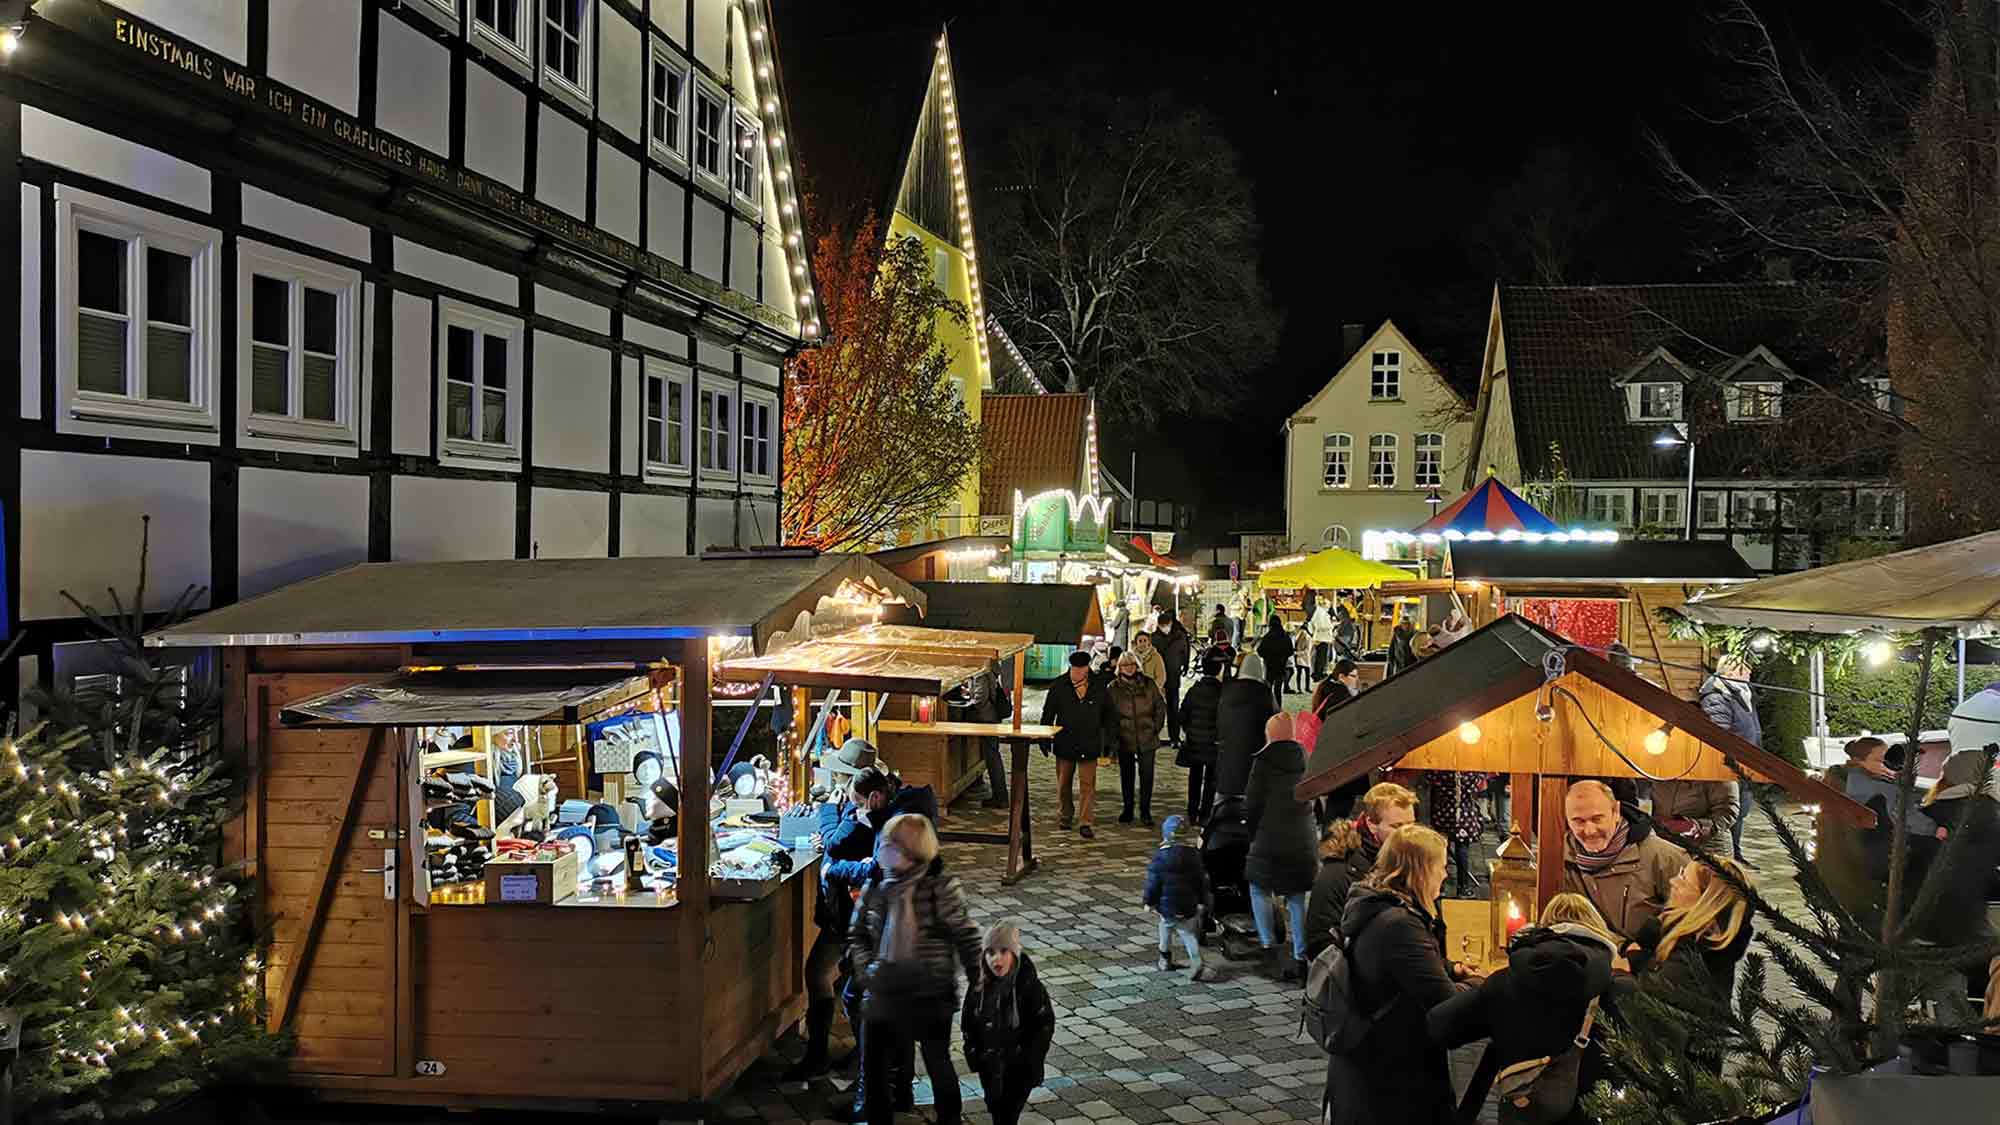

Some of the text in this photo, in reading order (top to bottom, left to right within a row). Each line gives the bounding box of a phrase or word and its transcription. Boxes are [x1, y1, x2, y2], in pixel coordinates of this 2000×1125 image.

[115, 18, 213, 81] EINSTMALS
[223, 67, 256, 100] WAR
[268, 87, 293, 115] ICH
[302, 102, 328, 129] EIN
[423, 1062, 438, 1073] 24
